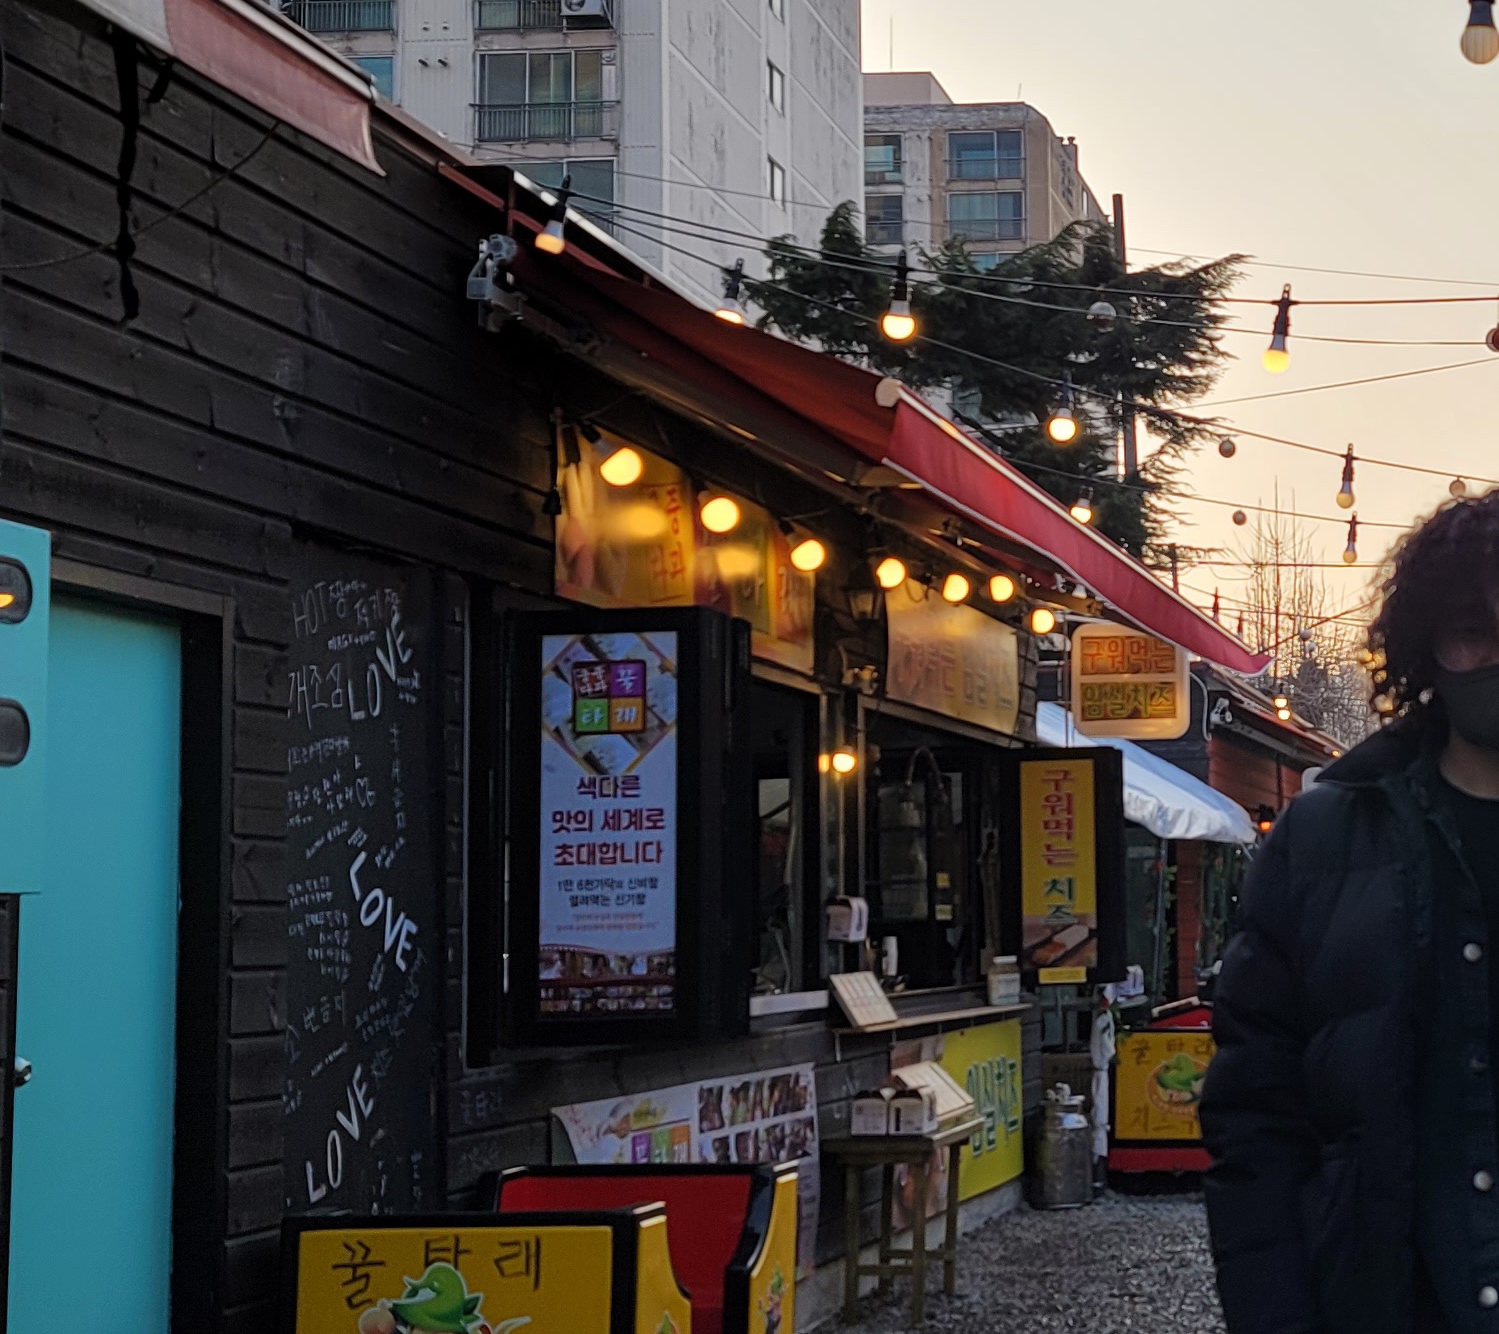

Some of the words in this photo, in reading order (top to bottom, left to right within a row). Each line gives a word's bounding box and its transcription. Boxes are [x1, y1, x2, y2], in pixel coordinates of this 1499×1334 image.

[293, 581, 327, 639] HOT
[347, 611, 414, 720] LOVE
[1084, 637, 1174, 672] 구워먹는
[577, 775, 641, 799] 색다른
[552, 810, 593, 834] 맛의
[600, 808, 665, 832] 세계로
[1041, 769, 1078, 867] 구워먹는
[553, 841, 663, 867] 초대합니다
[348, 850, 419, 973] LOVE
[1043, 877, 1078, 926] 치즈
[305, 1063, 375, 1205] LOVE
